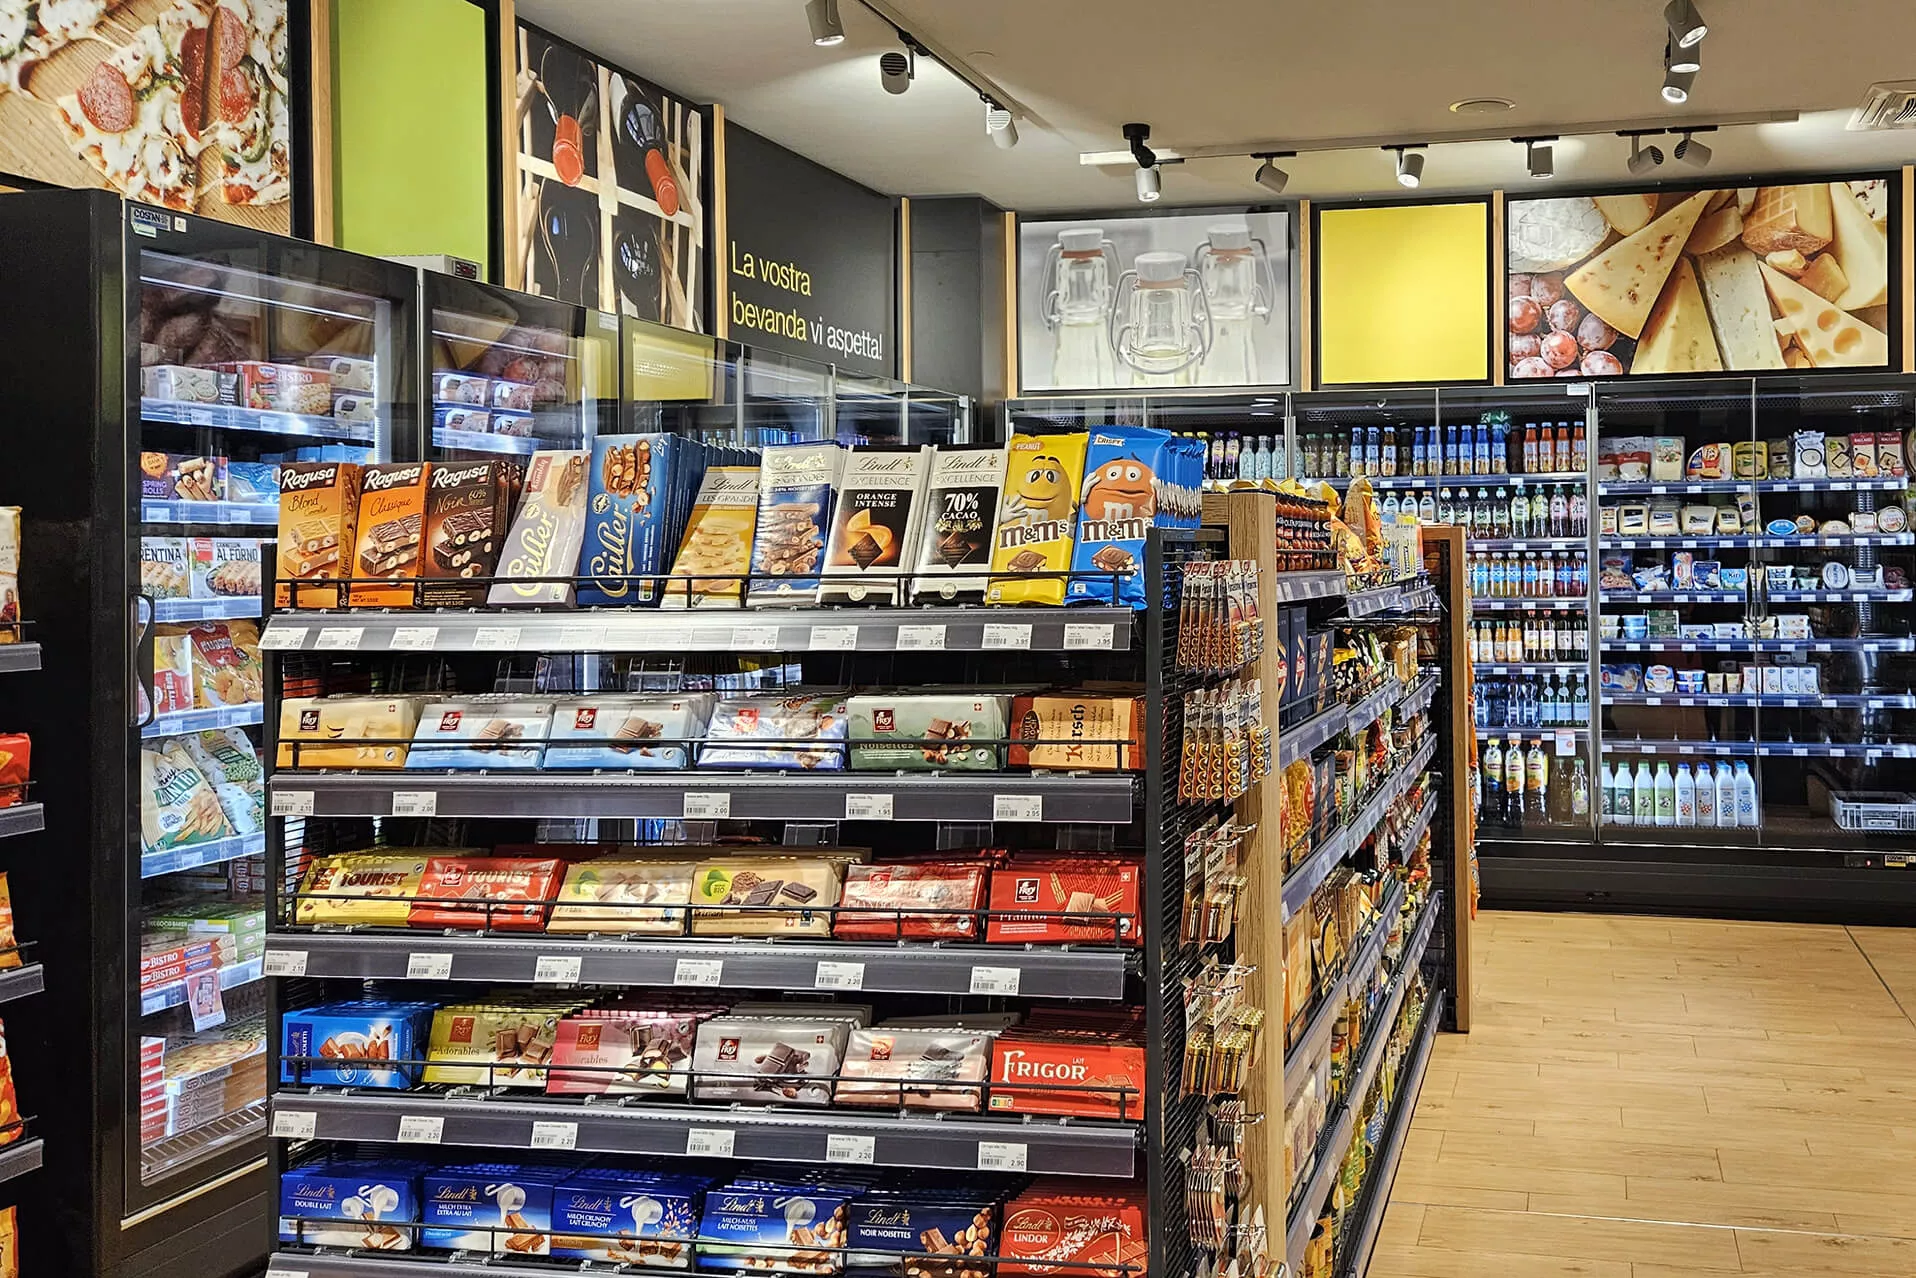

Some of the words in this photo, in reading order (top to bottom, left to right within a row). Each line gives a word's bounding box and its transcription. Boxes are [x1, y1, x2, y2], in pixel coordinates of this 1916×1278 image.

[732, 241, 755, 279] La
[759, 258, 811, 296] vostra
[732, 291, 807, 341] bevanda
[810, 316, 823, 345] vi
[827, 325, 882, 360] aspetta!
[1016, 443, 1041, 451] PEANUT
[856, 456, 903, 471] Lindt
[939, 455, 987, 470] Lindt
[281, 466, 336, 490] Ragusa
[364, 466, 422, 490] Ragusa
[431, 465, 489, 489] Ragusa
[708, 478, 753, 491] Lindt
[288, 493, 319, 512] Blond
[855, 500, 897, 508] INTENSE
[856, 493, 897, 501] ORANGE
[944, 493, 979, 512] 70%
[370, 497, 412, 516] Classique
[942, 512, 978, 521] CACAO
[229, 549, 258, 561] FORNO
[590, 503, 627, 598] Cailler
[1066, 703, 1087, 763] Krsch
[340, 872, 408, 887] TOURIST
[467, 870, 534, 885] TOURIST
[151, 952, 178, 967] BISTRO
[151, 966, 180, 981] BISTRO
[436, 1046, 480, 1057] Adorables
[1002, 1050, 1086, 1083] FRIGOR
[295, 1184, 326, 1198] Lindt
[435, 1185, 470, 1200] Lindt
[295, 1200, 319, 1209] DOUBLE
[319, 1202, 332, 1210] LAIT
[571, 1194, 603, 1210] Lindt
[721, 1196, 756, 1212] Lindt
[567, 1213, 585, 1221] MILCH
[585, 1214, 612, 1223] CRUNCHY
[569, 1219, 581, 1227] LAIT
[581, 1220, 608, 1229] CRUNCHY
[866, 1210, 900, 1226] Lindt
[1013, 1216, 1045, 1231] Lindt
[718, 1222, 730, 1230] LAIT
[860, 1228, 877, 1238] NOIR
[877, 1229, 912, 1239] NOISETTES
[1013, 1233, 1048, 1245] LINDOR
